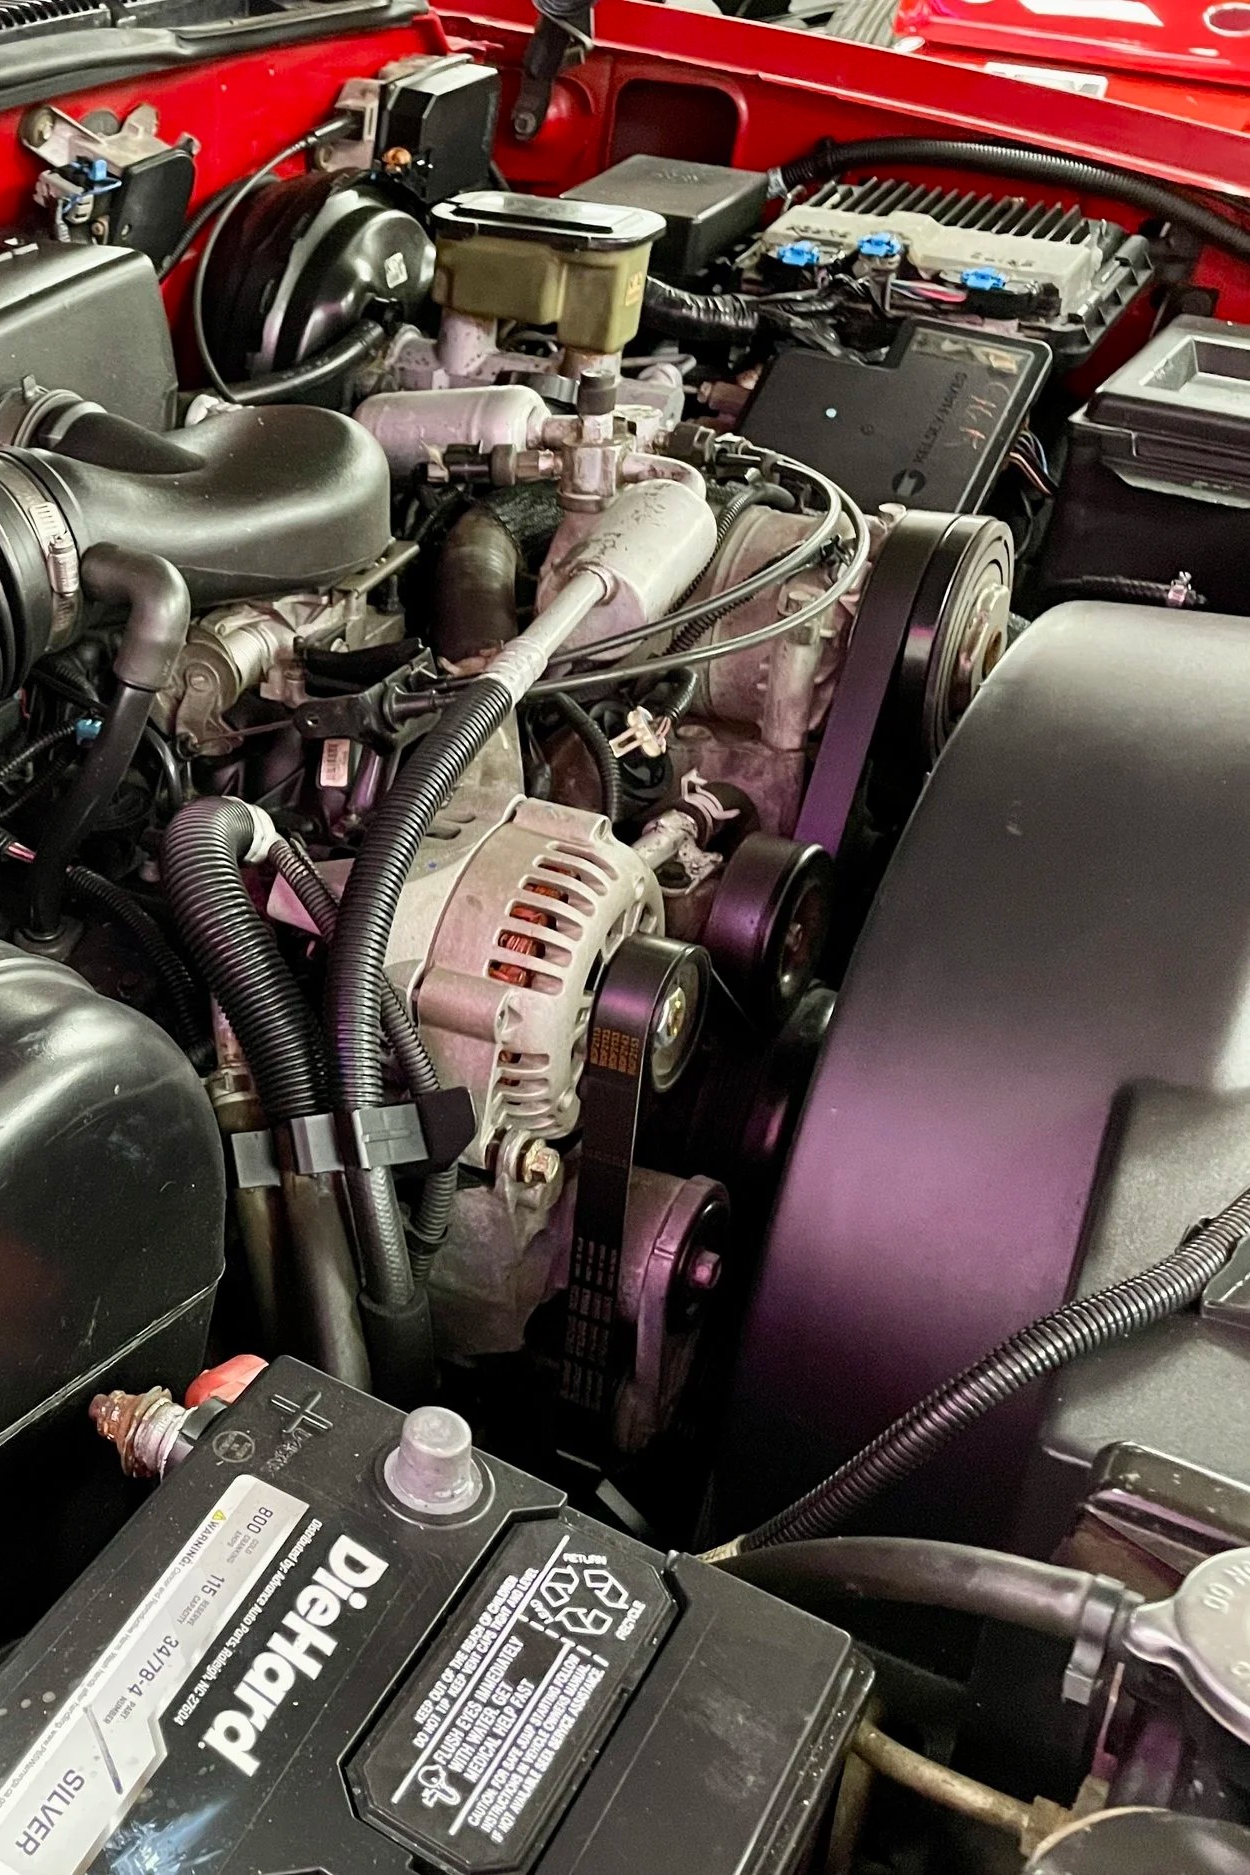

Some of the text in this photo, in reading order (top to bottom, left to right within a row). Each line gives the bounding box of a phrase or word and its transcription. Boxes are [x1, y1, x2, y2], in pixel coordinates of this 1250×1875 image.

[245, 1506, 274, 1535] 800
[287, 1517, 324, 1564] Distributed
[562, 1552, 608, 1566] RETURN
[200, 1573, 226, 1598] 115
[255, 1569, 286, 1607] Advance
[176, 1594, 202, 1625] CAPACITY
[185, 1599, 211, 1627] RESERVE
[242, 1602, 263, 1627] Auto
[615, 1599, 646, 1641] RECYCLE
[224, 1622, 250, 1649] Parts,
[413, 1698, 435, 1725] KEEP
[427, 1680, 448, 1702] OUT
[440, 1666, 456, 1684] OF
[448, 1649, 470, 1671] THE
[459, 1623, 487, 1654] REACH
[485, 1574, 519, 1615] CHILDREN
[126, 1634, 180, 1697] 34/78-4
[201, 1646, 234, 1681] Raleigh,
[412, 1730, 430, 1749] DO
[422, 1712, 442, 1735] NOT
[434, 1697, 451, 1715] TIP
[446, 1672, 468, 1698] KEEP
[460, 1650, 483, 1675] VENT
[472, 1628, 498, 1654] CAPS
[487, 1604, 513, 1632] TIGHT
[515, 1566, 540, 1592] LEVEL
[193, 1679, 211, 1698] NC
[432, 1634, 525, 1766] FLUSH EYES IMMEDIATELY
[102, 1695, 128, 1725] NUMBER
[119, 1700, 137, 1720] PART
[172, 1692, 201, 1727] 27604
[447, 1742, 476, 1774] WITH
[490, 1679, 514, 1707] GET
[489, 1767, 511, 1791] FOR
[501, 1745, 525, 1772] SAFE
[528, 1684, 562, 1728] STARTING
[552, 1652, 581, 1689] FOLLOW
[462, 1677, 536, 1784] MEDICAL HELP FAST
[479, 1772, 525, 1834] INSTRUCTIONS
[521, 1728, 551, 1764] VEHICLE
[496, 1810, 516, 1834] NOT
[508, 1768, 543, 1816] AVAILABLE
[546, 1712, 577, 1751] SERVICE
[14, 1768, 86, 1857] SILVER
